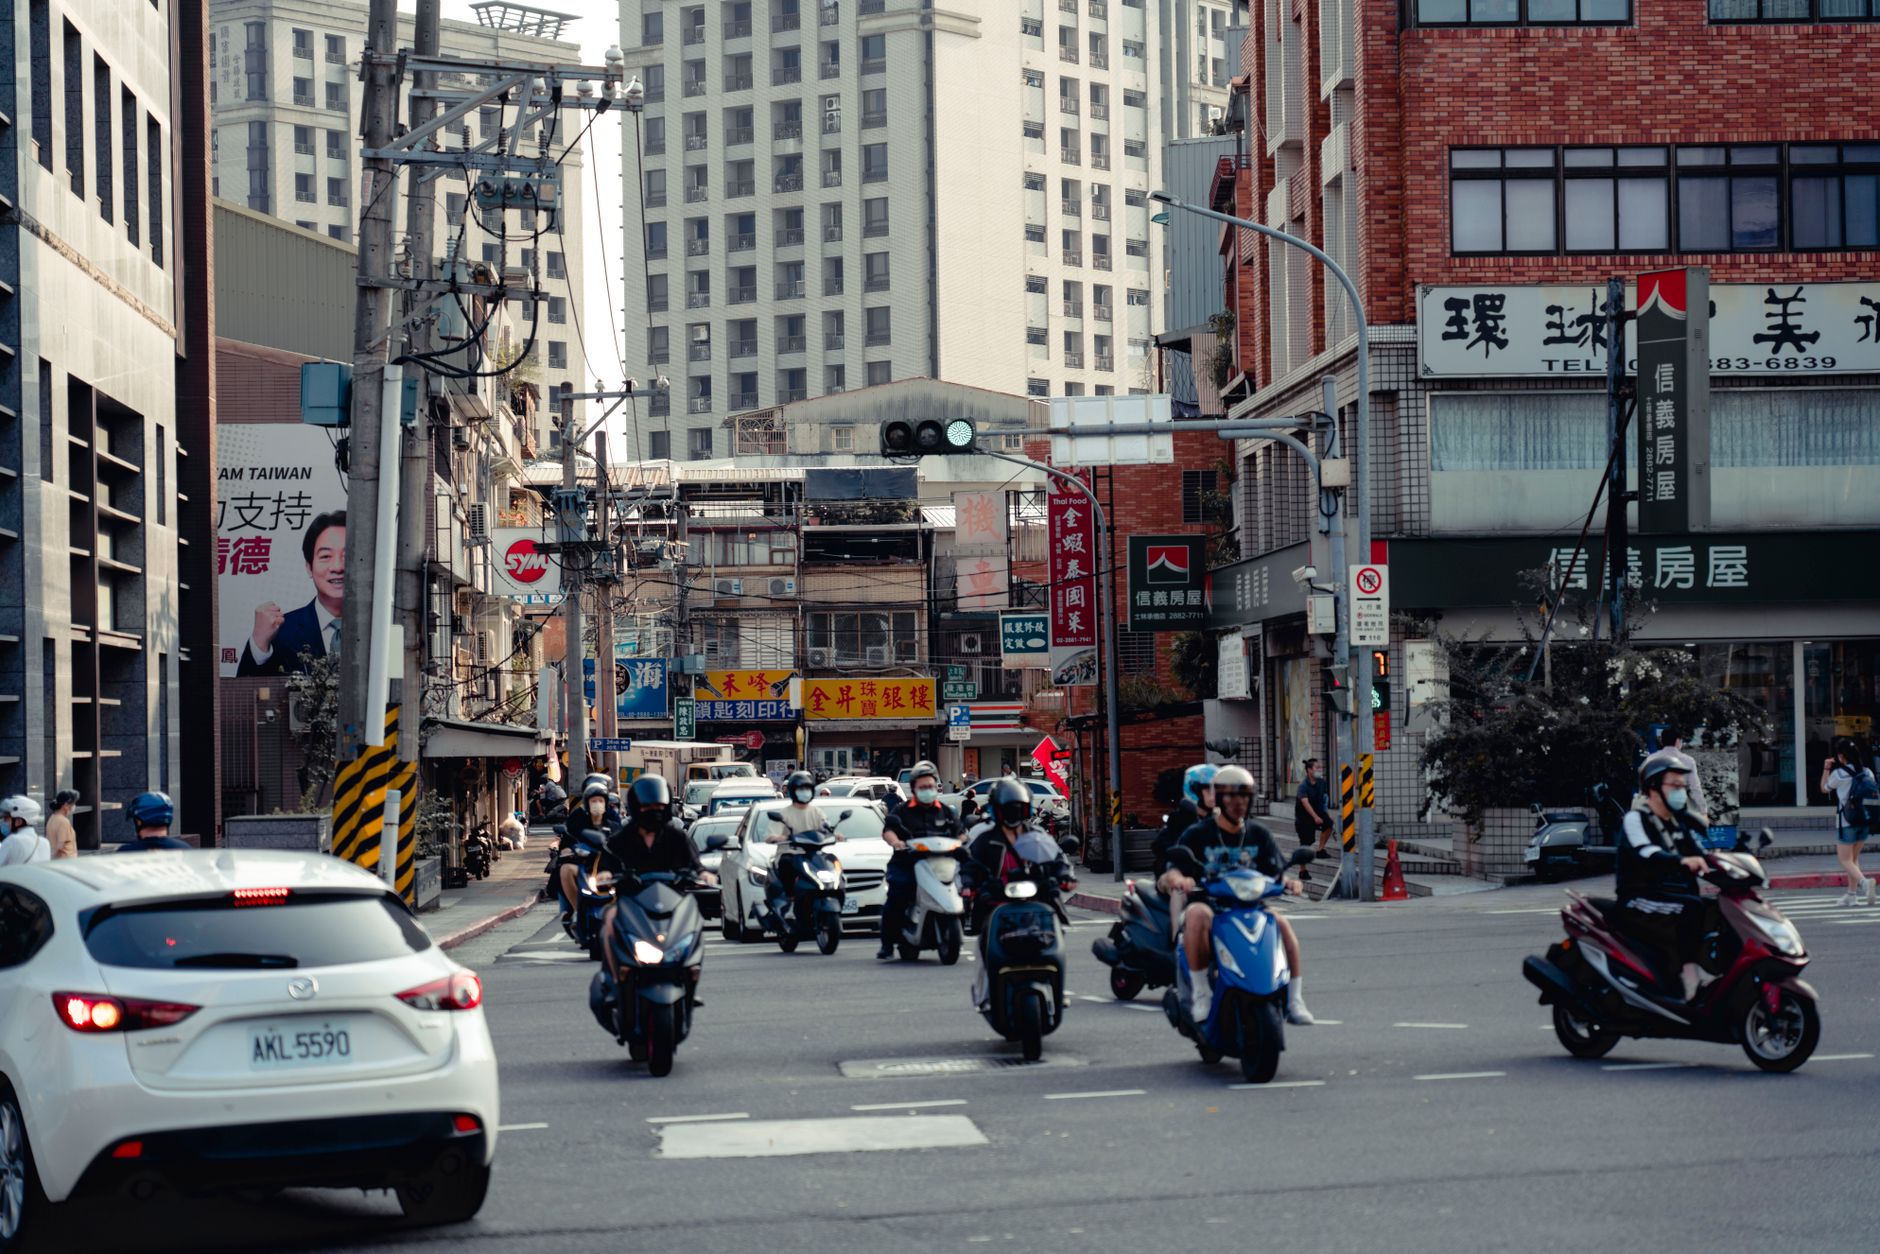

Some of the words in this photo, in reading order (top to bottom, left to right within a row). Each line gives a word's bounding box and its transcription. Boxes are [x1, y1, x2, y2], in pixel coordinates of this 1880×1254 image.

[1441, 286, 1880, 358] 環球美
[1654, 363, 1676, 500] 信義房屋
[217, 467, 244, 480] AM
[249, 467, 312, 480] TAIWAN
[961, 495, 1002, 608] 機車
[504, 553, 549, 575] SYM
[1062, 507, 1089, 634] 金蝦泰國菜
[1136, 590, 1202, 606] 信義房屋
[1169, 611, 1204, 619] 2882-7711
[635, 662, 662, 689] 海
[695, 700, 797, 720] 鎖匙刻印行
[950, 707, 961, 721] P
[594, 740, 602, 749] P
